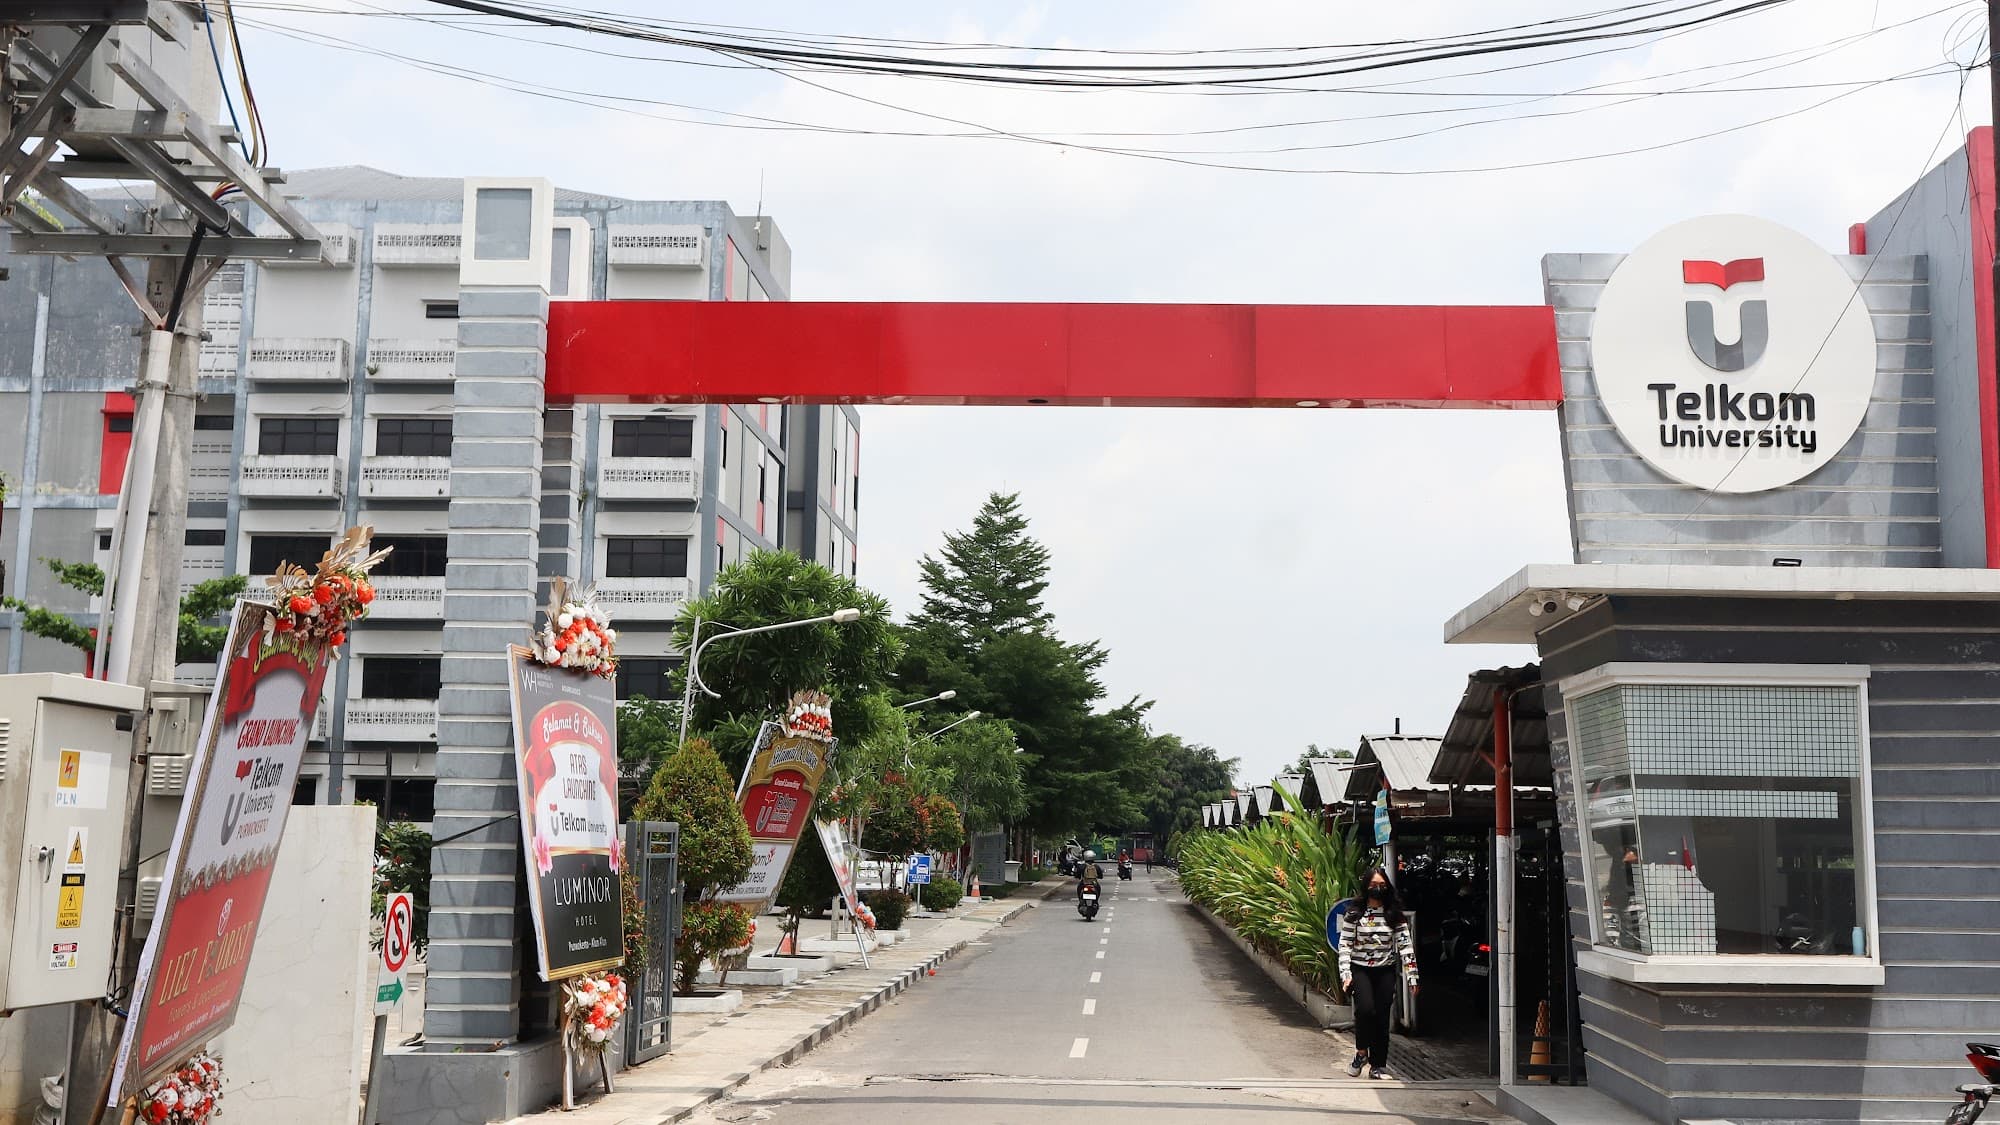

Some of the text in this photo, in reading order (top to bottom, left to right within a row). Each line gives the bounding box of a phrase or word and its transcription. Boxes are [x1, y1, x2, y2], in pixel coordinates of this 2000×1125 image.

[1647, 383, 1816, 422] Telkom
[1660, 424, 1817, 453] University
[237, 719, 299, 750] GRAND LAUNCHING
[543, 712, 603, 744] Selamat & Sukses
[250, 757, 284, 790] Telkom
[569, 753, 588, 775] ATAS
[56, 792, 77, 806] PLN
[563, 777, 596, 800] LAUNCHING
[244, 793, 275, 814] University
[560, 812, 587, 832] Telkom
[587, 820, 608, 836] University
[910, 857, 919, 871] P
[553, 876, 611, 906] LUMINOR
[59, 918, 78, 927] HAZARD
[575, 914, 598, 927] HOTEL
[158, 947, 199, 1006] LIEZ
